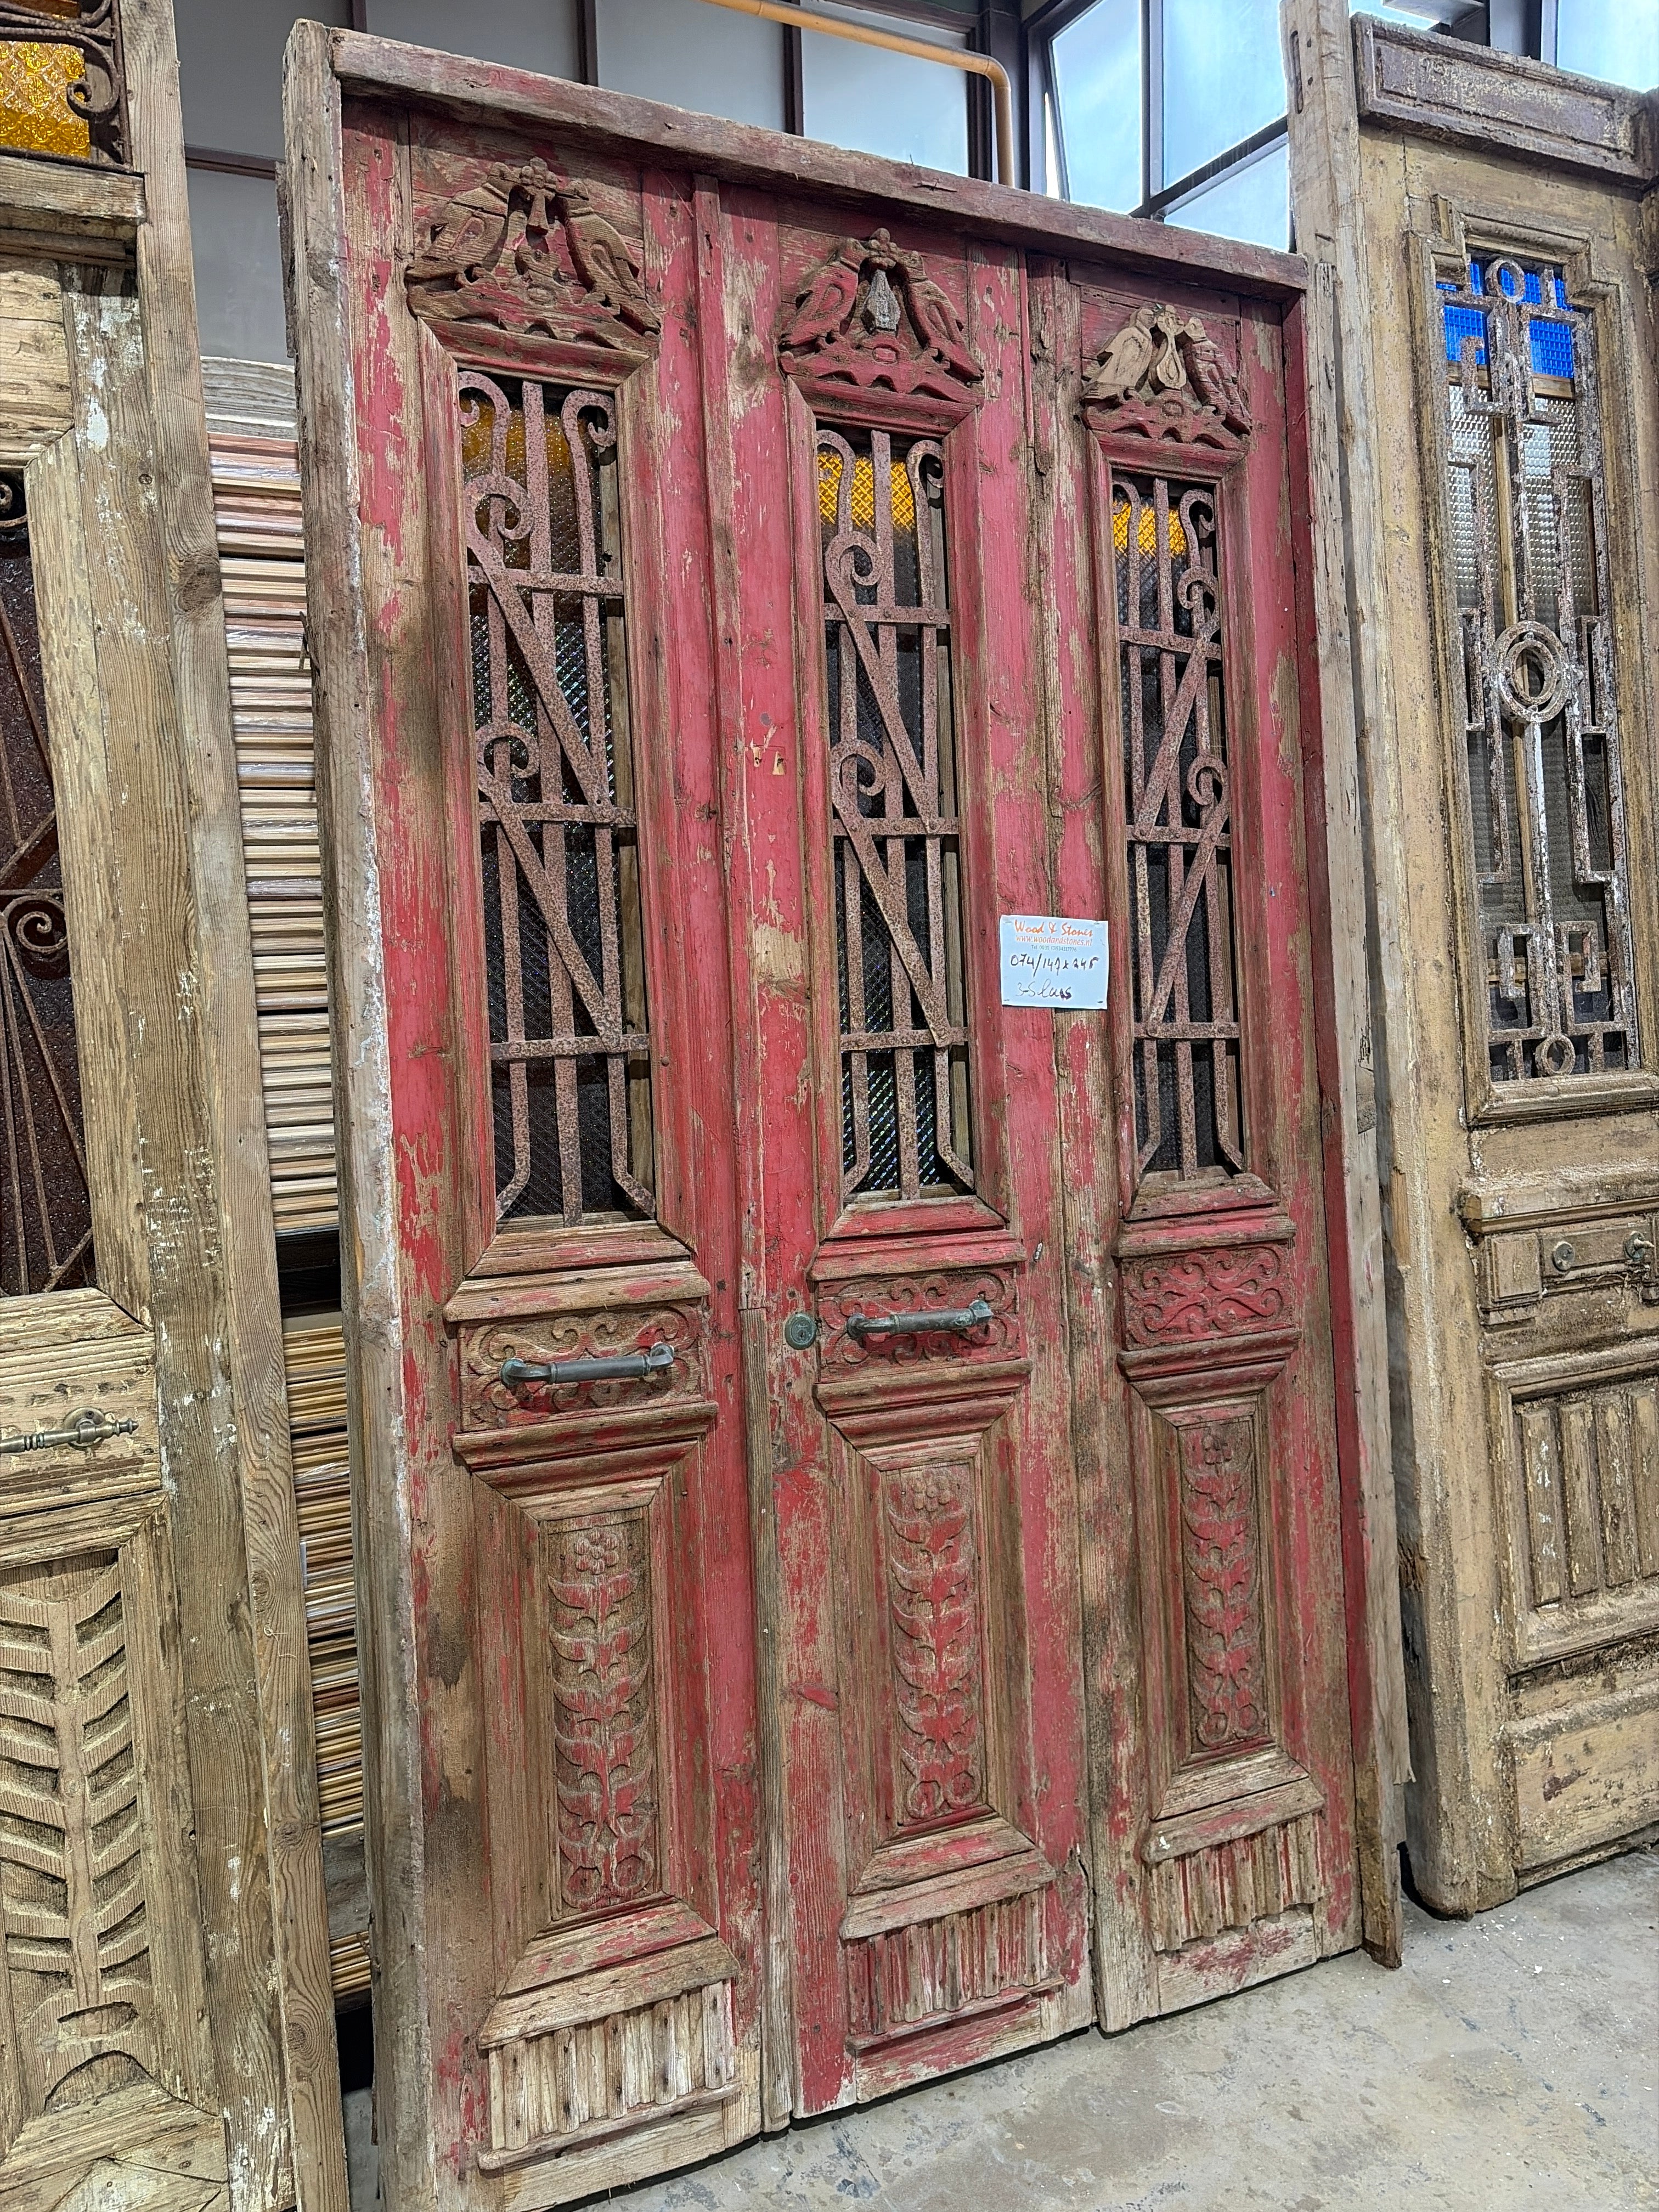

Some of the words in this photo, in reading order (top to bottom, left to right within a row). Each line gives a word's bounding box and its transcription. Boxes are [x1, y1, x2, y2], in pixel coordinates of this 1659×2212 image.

[1014, 919, 1044, 934] Wood
[1048, 921, 1057, 934] &
[1061, 922, 1093, 937] Stones
[1016, 935, 1092, 946] www.woodandstones.nl
